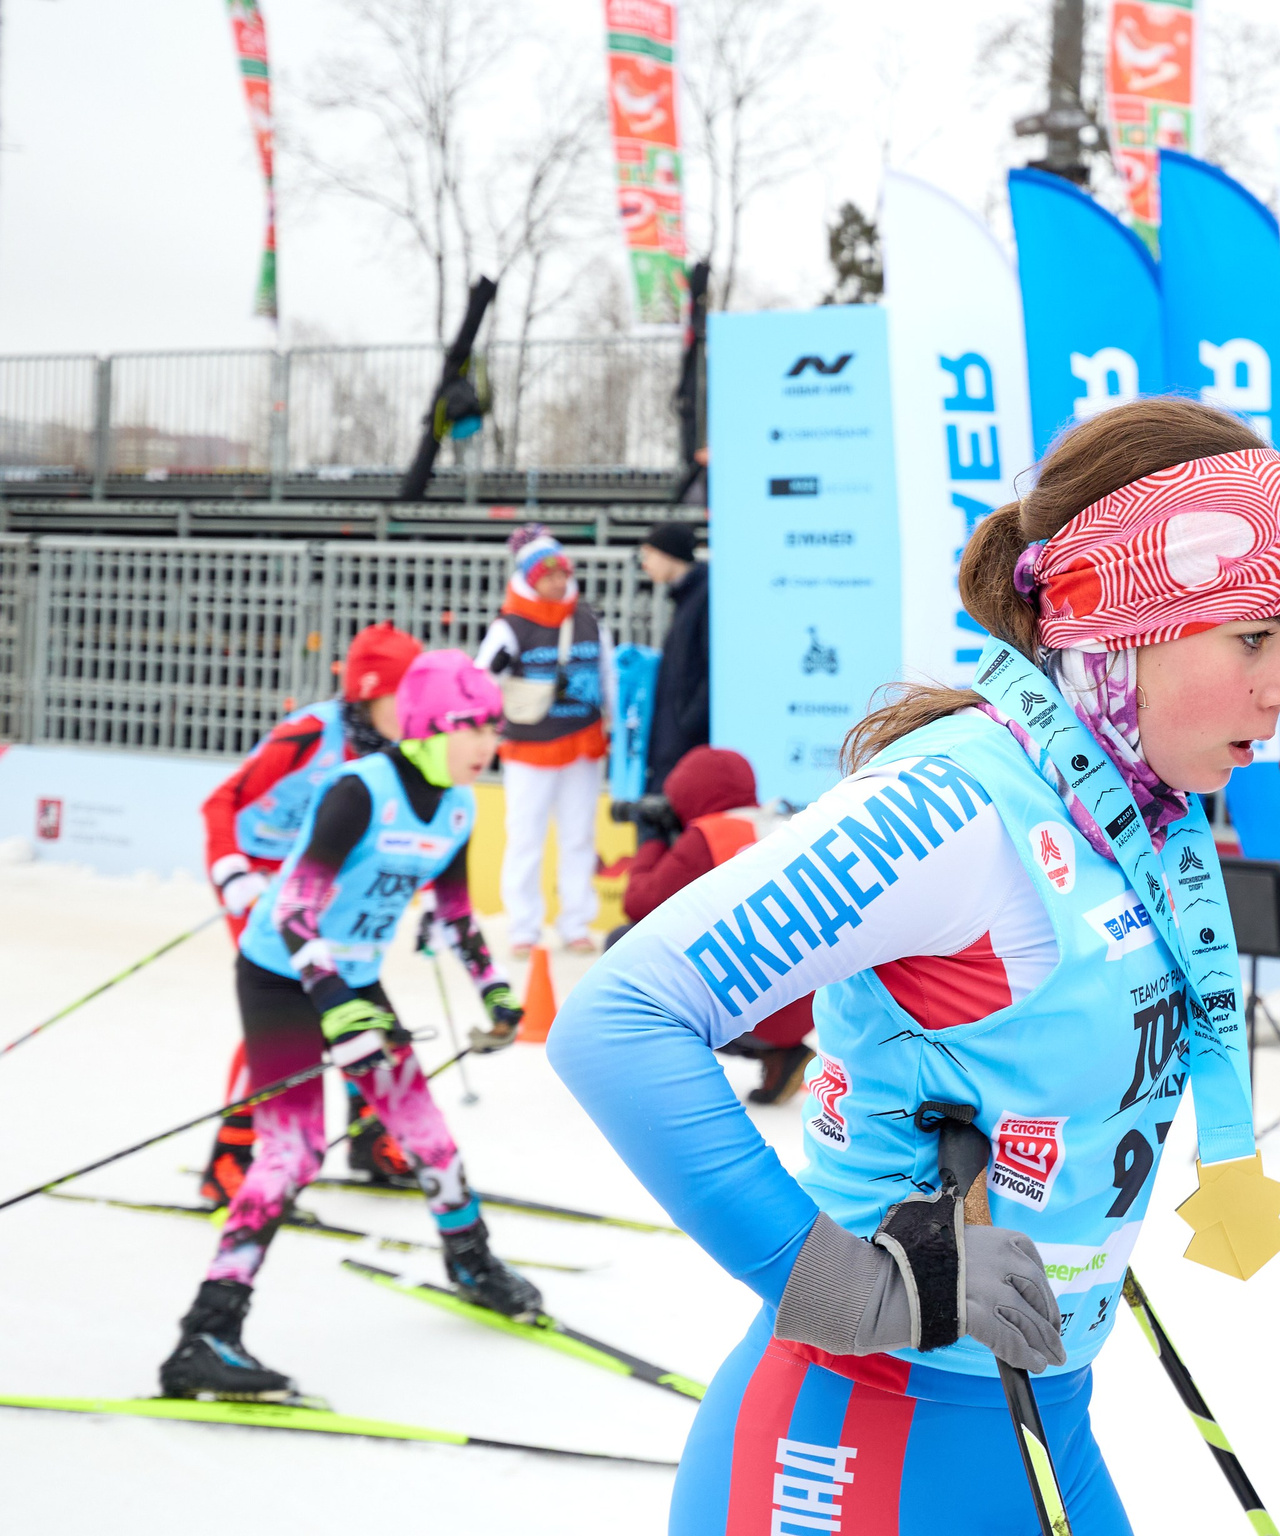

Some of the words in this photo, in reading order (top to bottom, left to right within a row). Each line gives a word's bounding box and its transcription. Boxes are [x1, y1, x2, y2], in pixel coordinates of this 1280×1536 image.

[1027, 702, 1059, 729] МОСКОВСКИЙ
[1040, 715, 1056, 729] СПОРТ
[1071, 759, 1107, 789] СОВКОМБАНК
[1117, 808, 1134, 826] MADE
[683, 756, 992, 1017] АКАДЕМИЯ
[1178, 872, 1211, 886] МОСКОВСКИЙ
[1188, 882, 1204, 891] СПОРТ
[1191, 943, 1229, 956] СОВКОМБАНК
[1130, 982, 1158, 1006] TEAM
[1158, 973, 1170, 992] OF
[1000, 1124, 1010, 1135] В
[1011, 1124, 1057, 1138] СПОРТЕ
[994, 1163, 1031, 1185] СПОРТИВНЫЙ
[992, 1171, 1044, 1203] ЛУКОЙЛ
